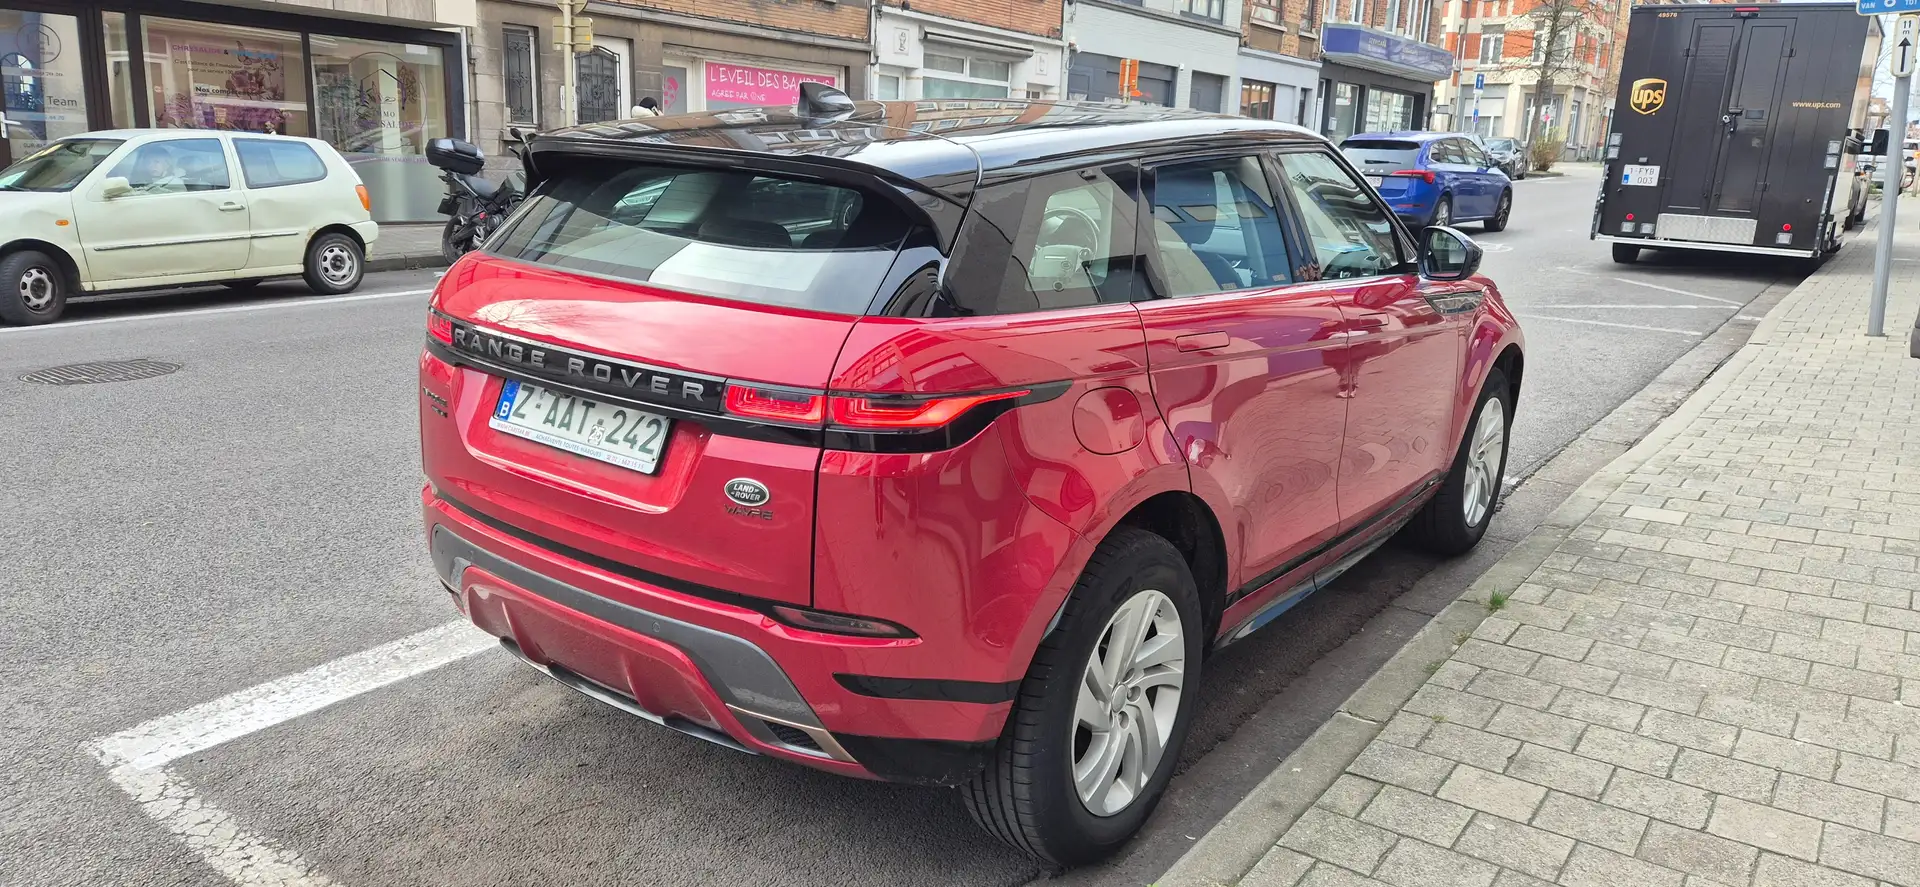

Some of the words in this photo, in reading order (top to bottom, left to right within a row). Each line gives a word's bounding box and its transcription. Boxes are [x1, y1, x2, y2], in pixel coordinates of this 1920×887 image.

[1903, 20, 1912, 29] 11
[758, 71, 780, 90] DES
[195, 86, 209, 94] Nos
[47, 96, 77, 107] Team
[1633, 88, 1664, 109] ups
[1792, 101, 1841, 110] www.ups.com
[1637, 176, 1654, 184] 003
[454, 328, 546, 369] RANGE
[567, 357, 705, 402] ROVER
[500, 401, 511, 417] B
[733, 483, 755, 493] LAND
[734, 491, 761, 501] ROVER
